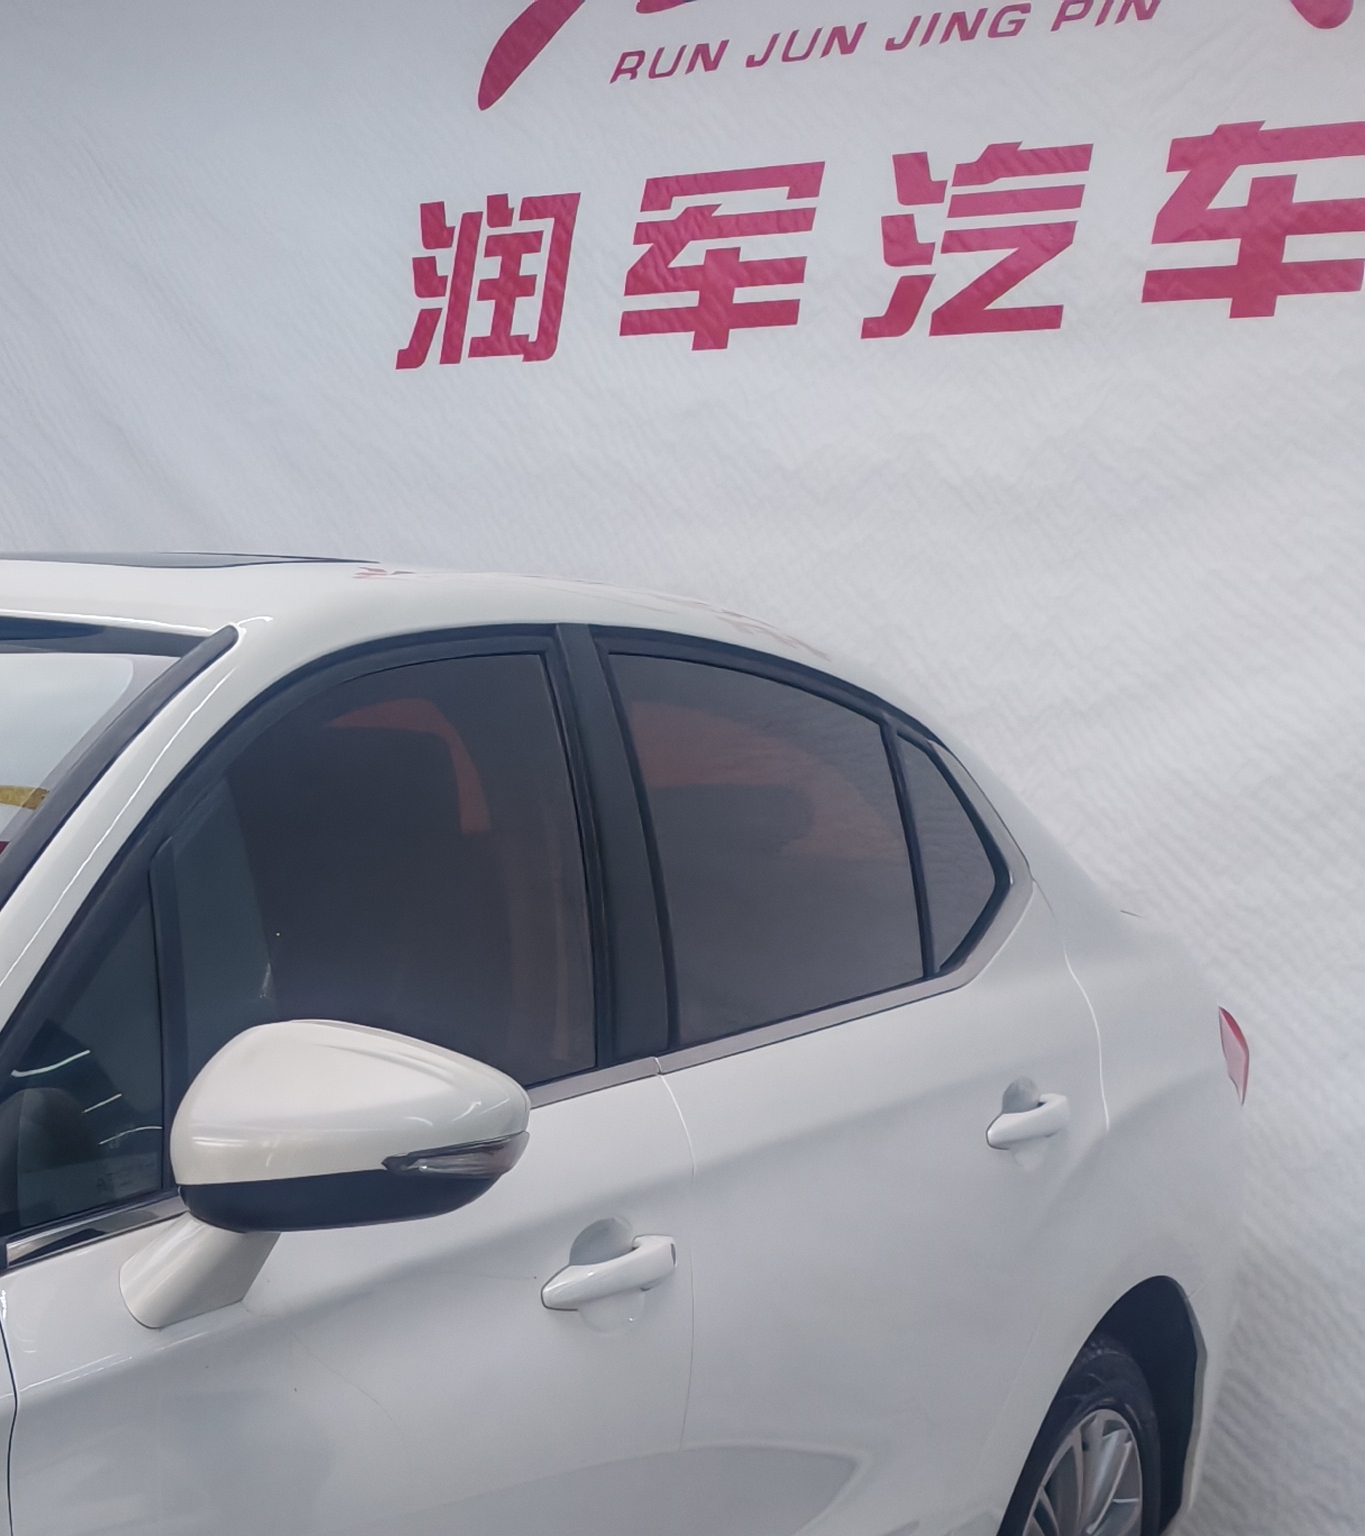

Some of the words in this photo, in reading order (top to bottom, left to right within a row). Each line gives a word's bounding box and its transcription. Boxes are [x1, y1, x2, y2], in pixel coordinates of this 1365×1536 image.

[610, 39, 730, 84] RUN
[745, 21, 867, 68] JUN
[884, 2, 1032, 51] JING
[1050, 0, 1162, 32] PIN
[395, 120, 1365, 371] 润军汽车
